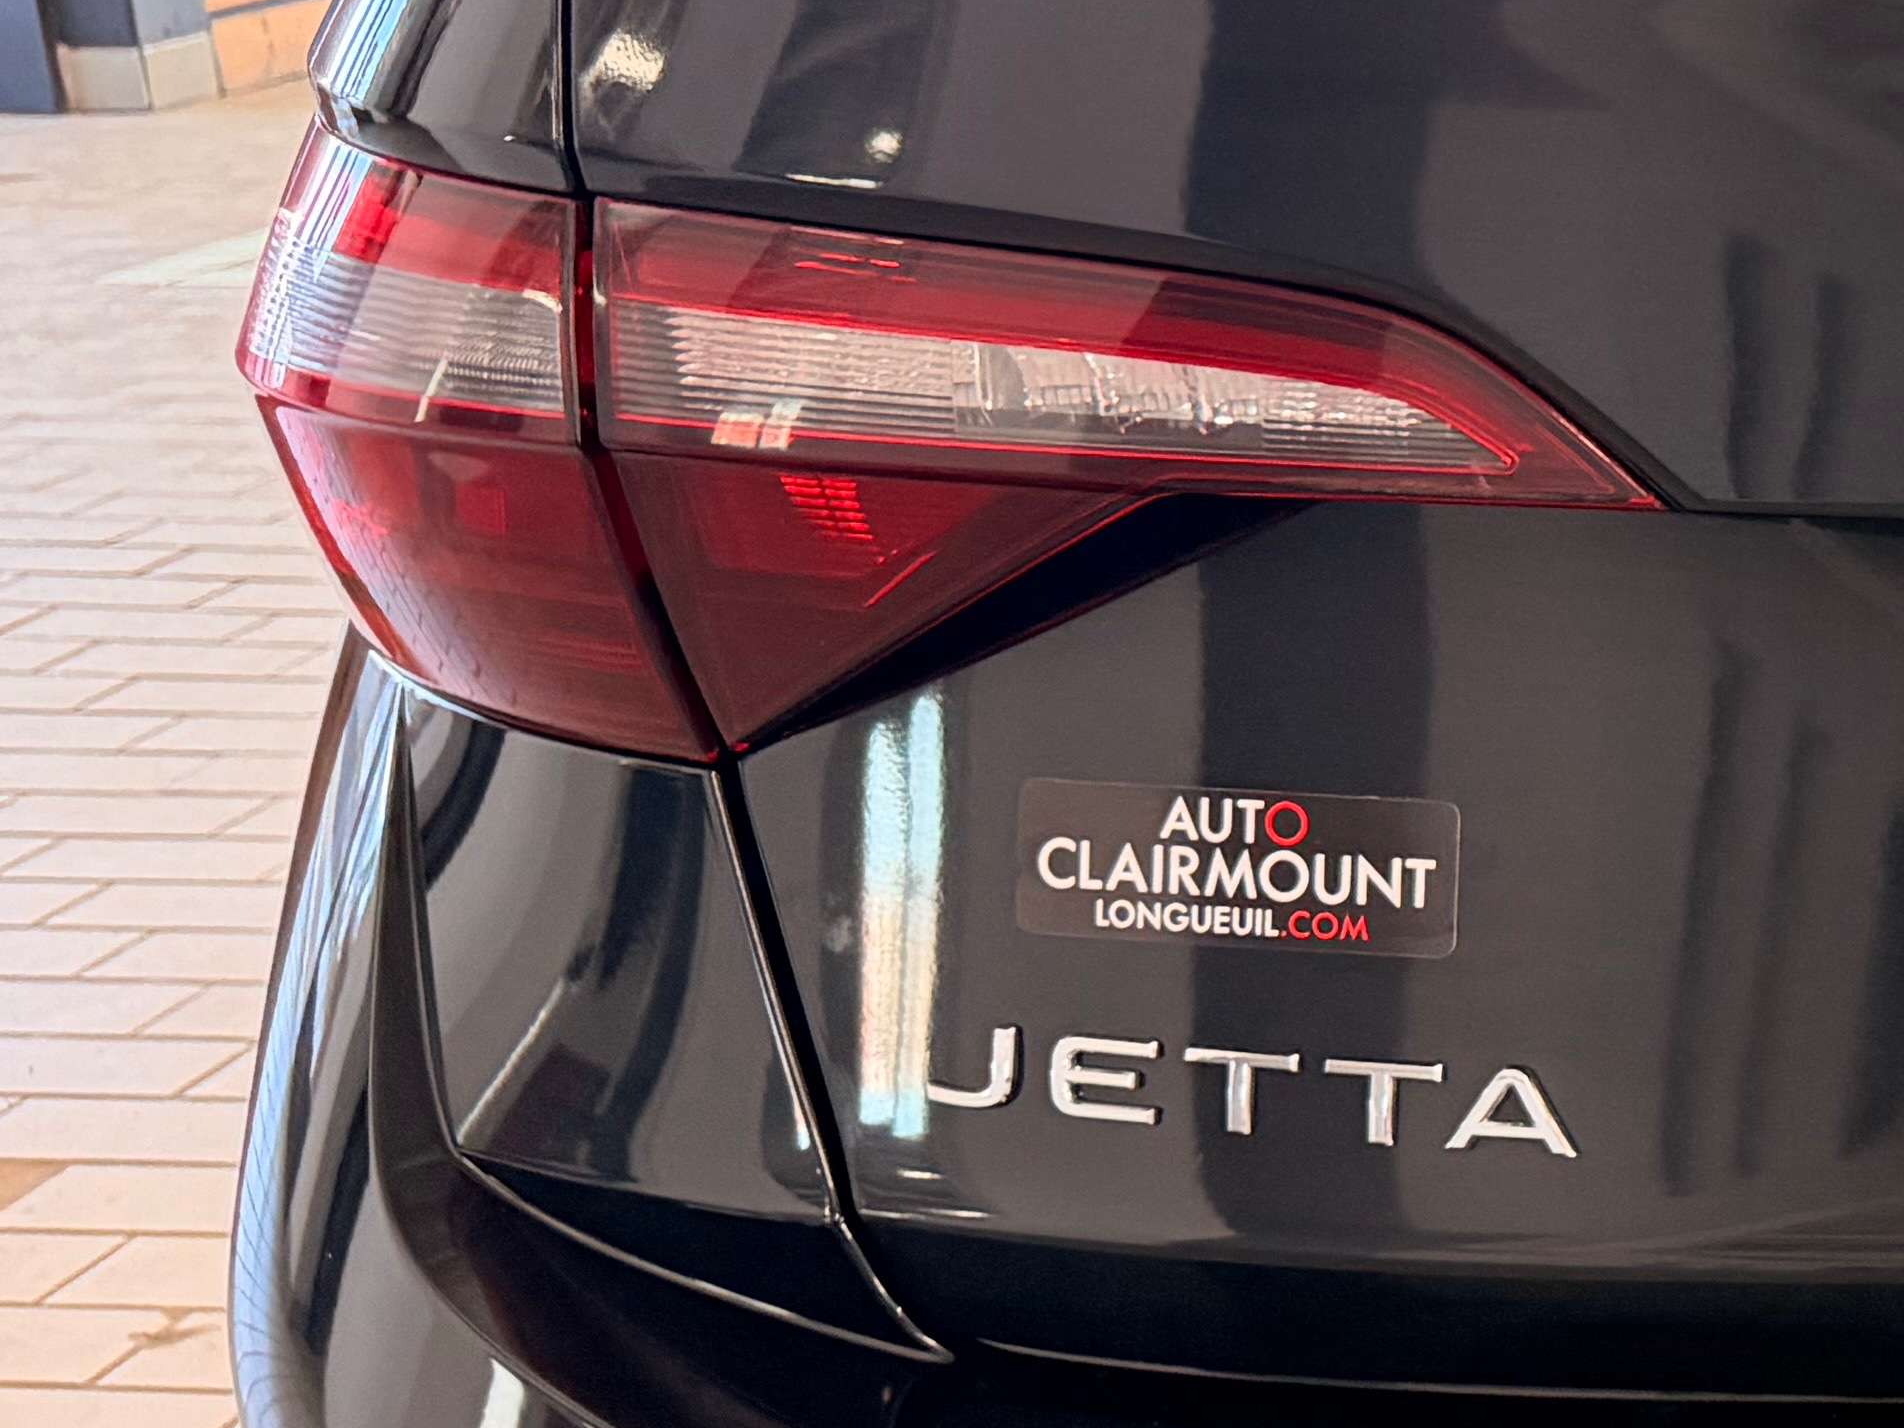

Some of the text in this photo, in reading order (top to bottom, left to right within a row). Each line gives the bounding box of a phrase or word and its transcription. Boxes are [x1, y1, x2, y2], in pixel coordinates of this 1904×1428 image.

[1159, 794, 1311, 847] AUTO
[1036, 835, 1438, 910] CLAIRMOUNT
[1094, 897, 1370, 942] LONGUEUIL.COM
[923, 1025, 1578, 1159] JETTA
